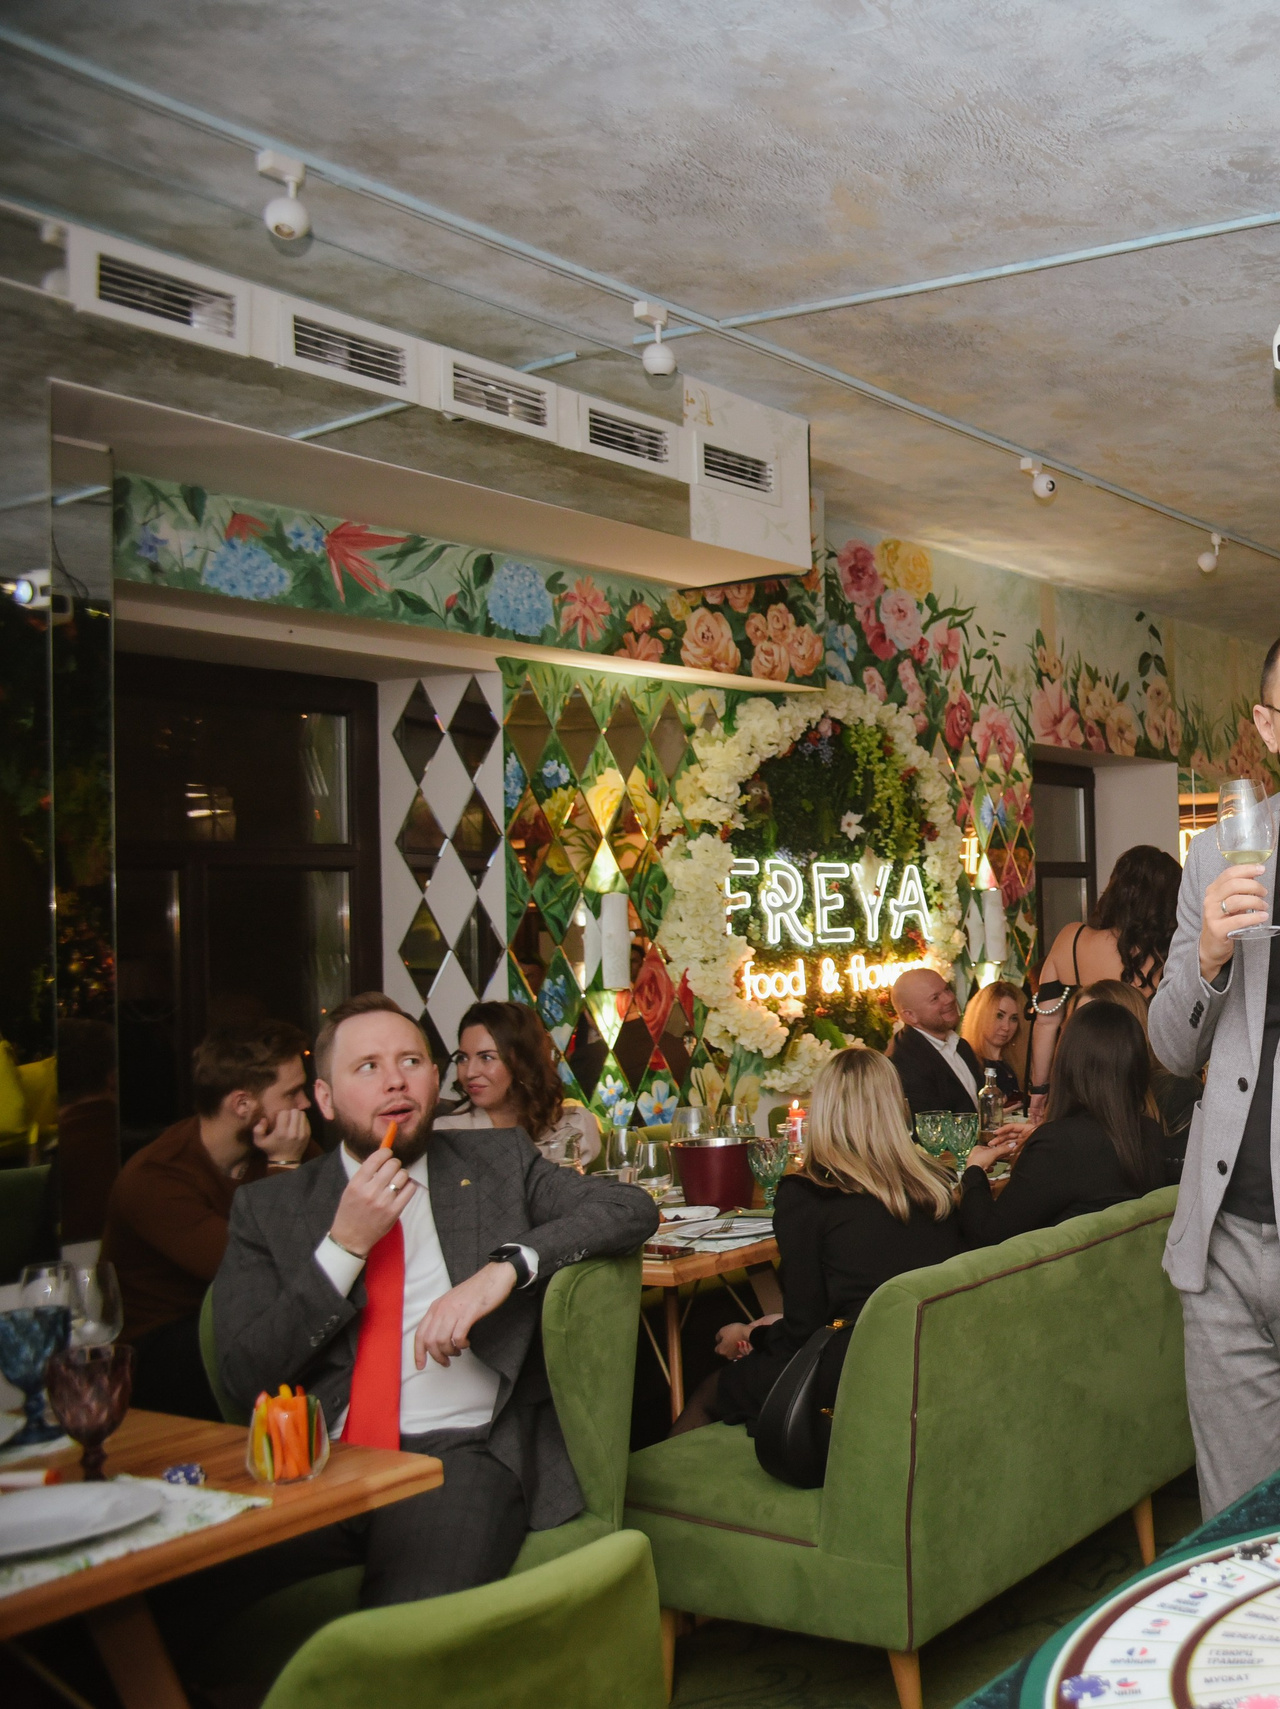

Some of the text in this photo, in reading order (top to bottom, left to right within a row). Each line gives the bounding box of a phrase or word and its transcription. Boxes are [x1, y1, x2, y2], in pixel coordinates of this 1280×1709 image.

[724, 858, 934, 946] FREYA
[741, 955, 807, 1001] food
[821, 957, 842, 994] &
